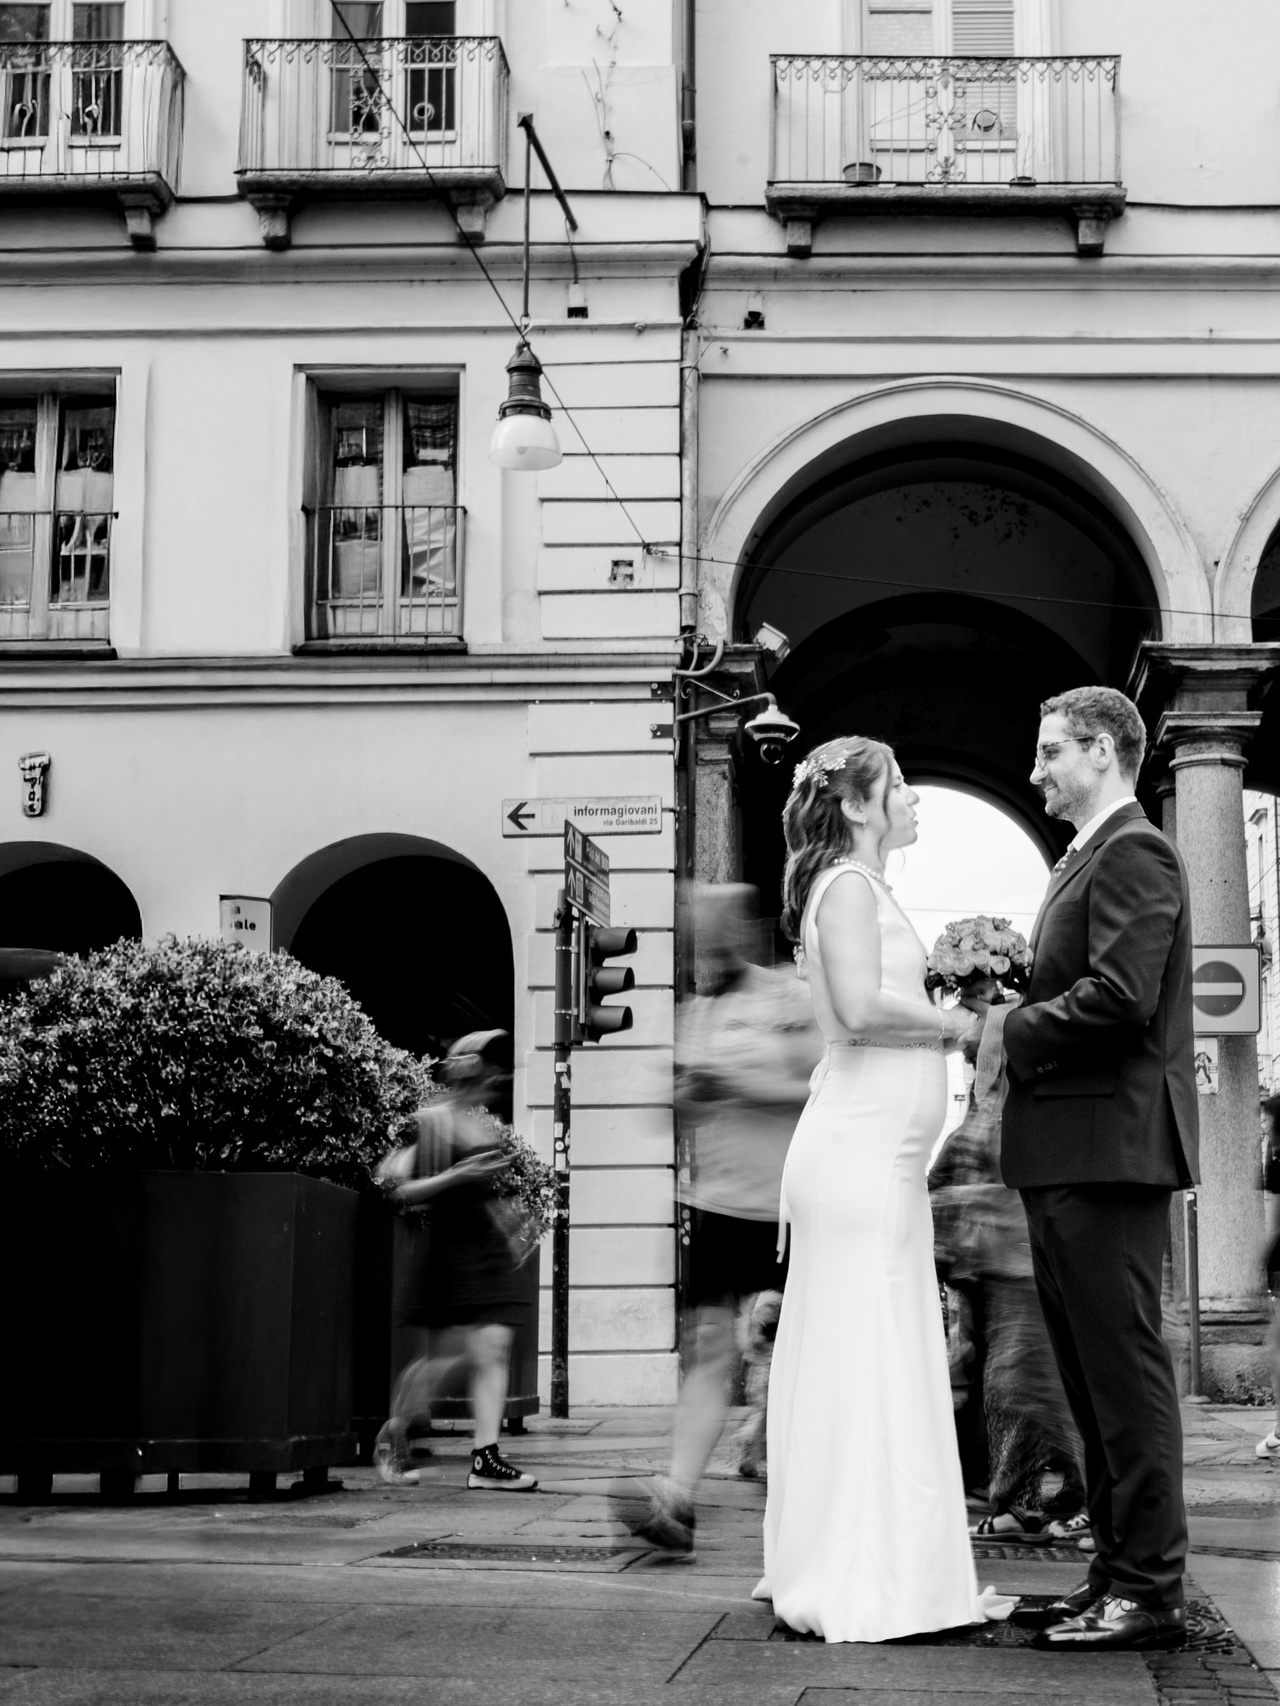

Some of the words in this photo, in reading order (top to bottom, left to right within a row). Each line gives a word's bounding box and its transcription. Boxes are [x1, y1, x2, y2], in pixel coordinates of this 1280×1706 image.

[574, 804, 658, 818] informagiovani
[602, 819, 614, 827] via
[615, 818, 648, 827] Garibaldi
[649, 817, 658, 826] 25
